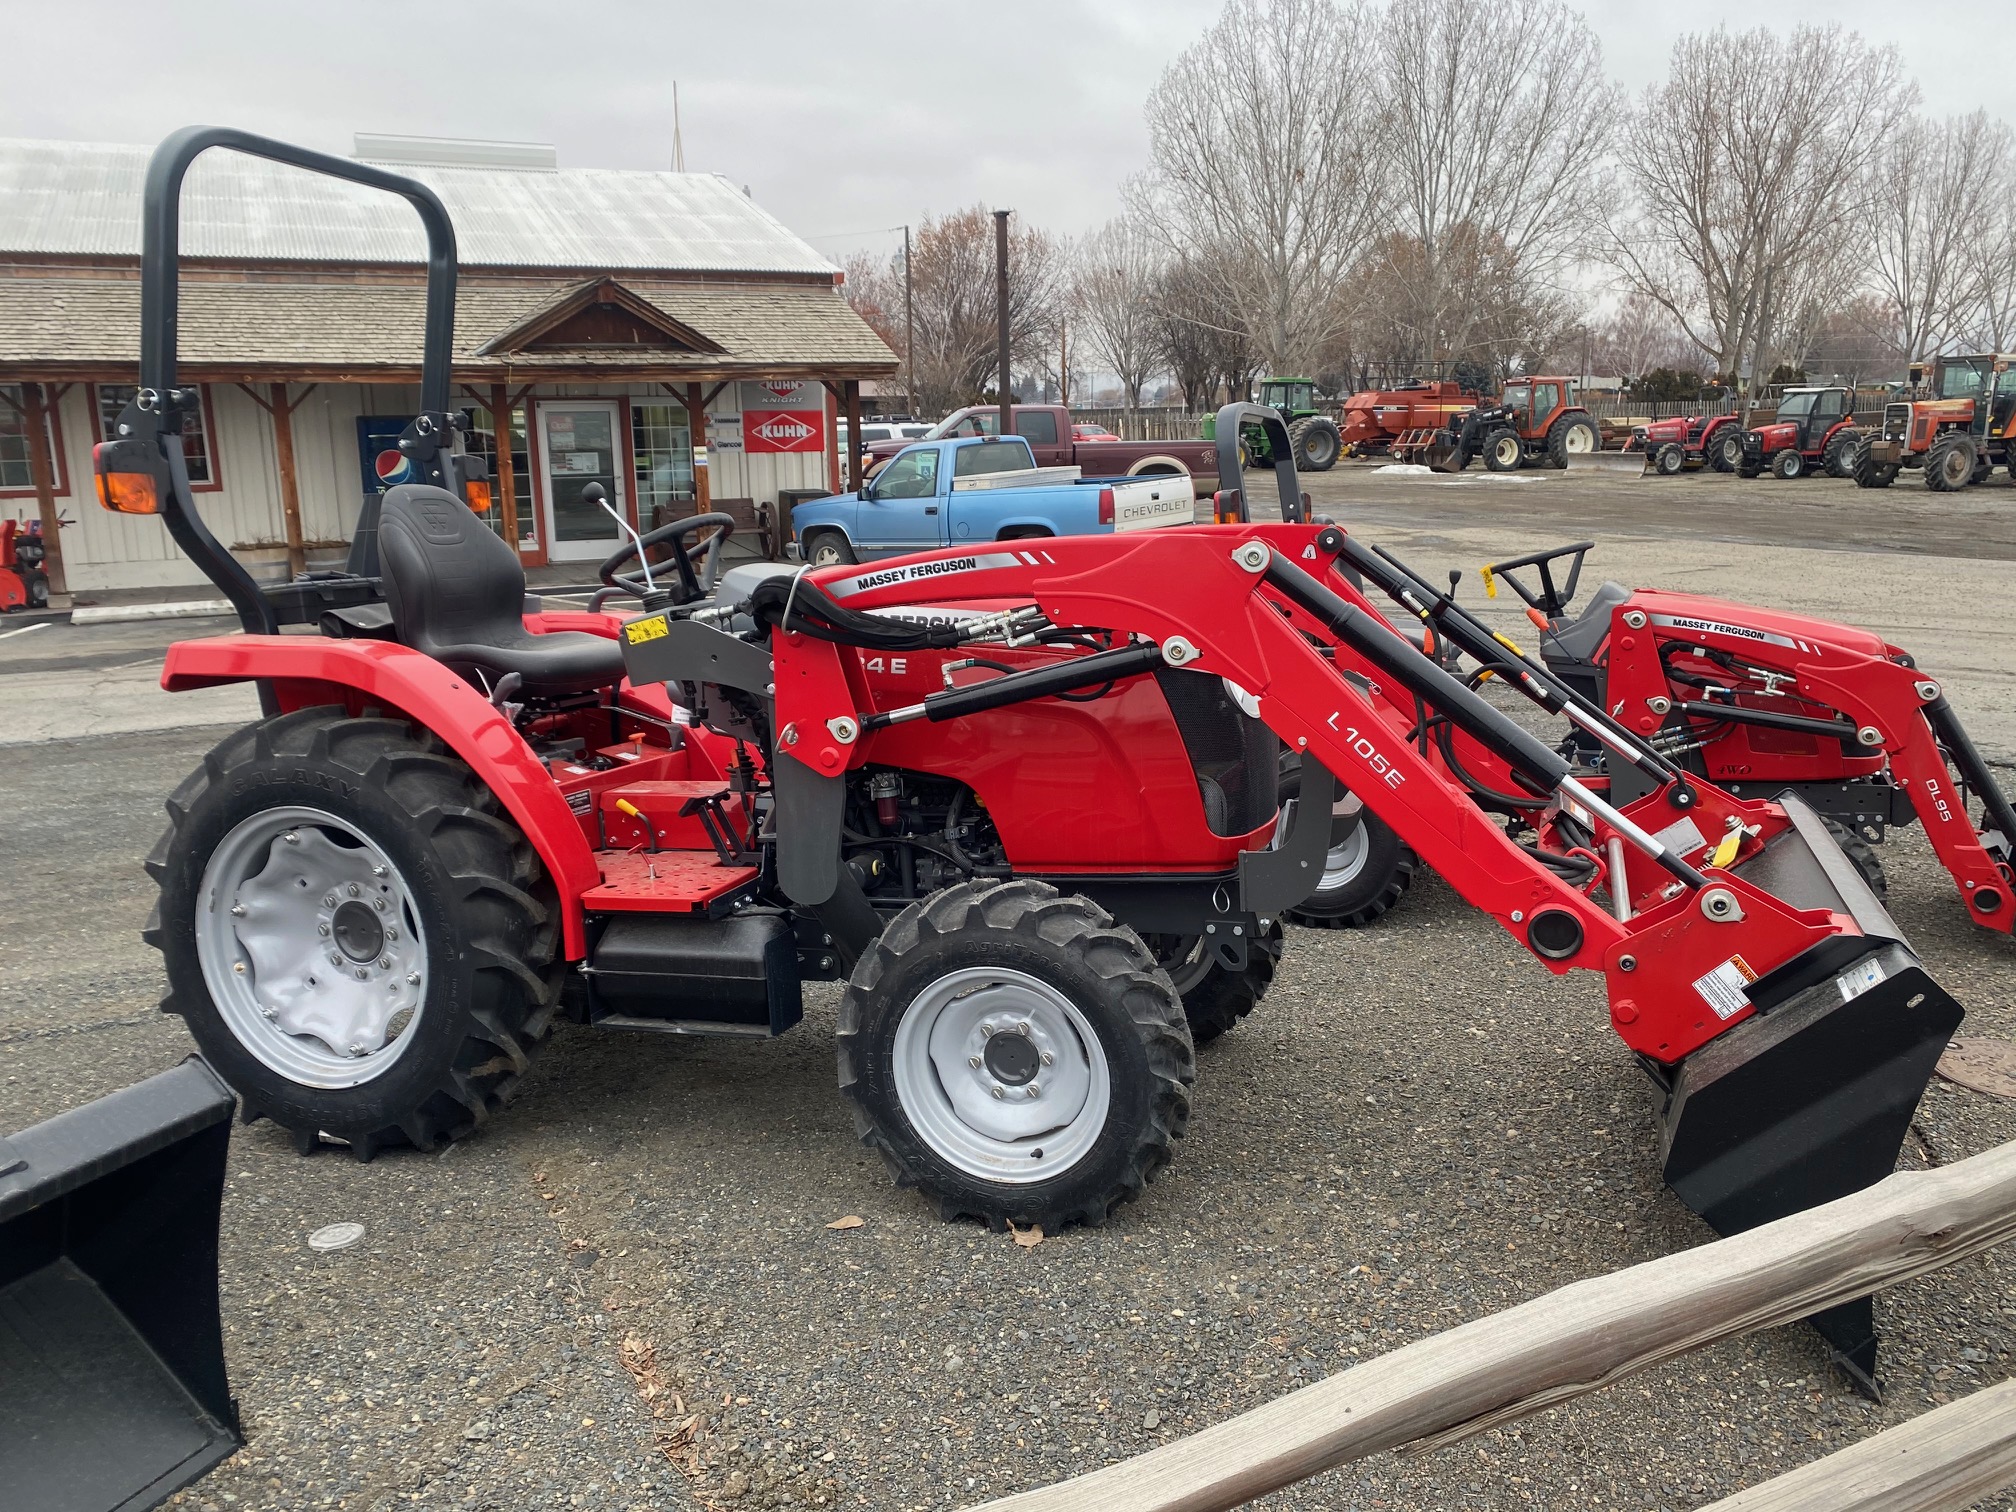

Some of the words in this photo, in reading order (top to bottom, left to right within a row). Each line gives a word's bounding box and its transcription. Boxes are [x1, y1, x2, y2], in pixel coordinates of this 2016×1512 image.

[766, 380, 800, 390] KUHN
[761, 425, 808, 438] KUHN
[716, 440, 743, 449] Glencoe
[1123, 500, 1187, 518] CHEVROLET
[857, 569, 907, 590] MASSEY
[910, 557, 977, 578] FERGUSON
[1672, 618, 1712, 631] MASSEY
[1713, 624, 1765, 640] FERGUSON
[1717, 765, 1752, 775] 4WD
[230, 768, 360, 799] GALAXY
[1925, 778, 1953, 823] DL95
